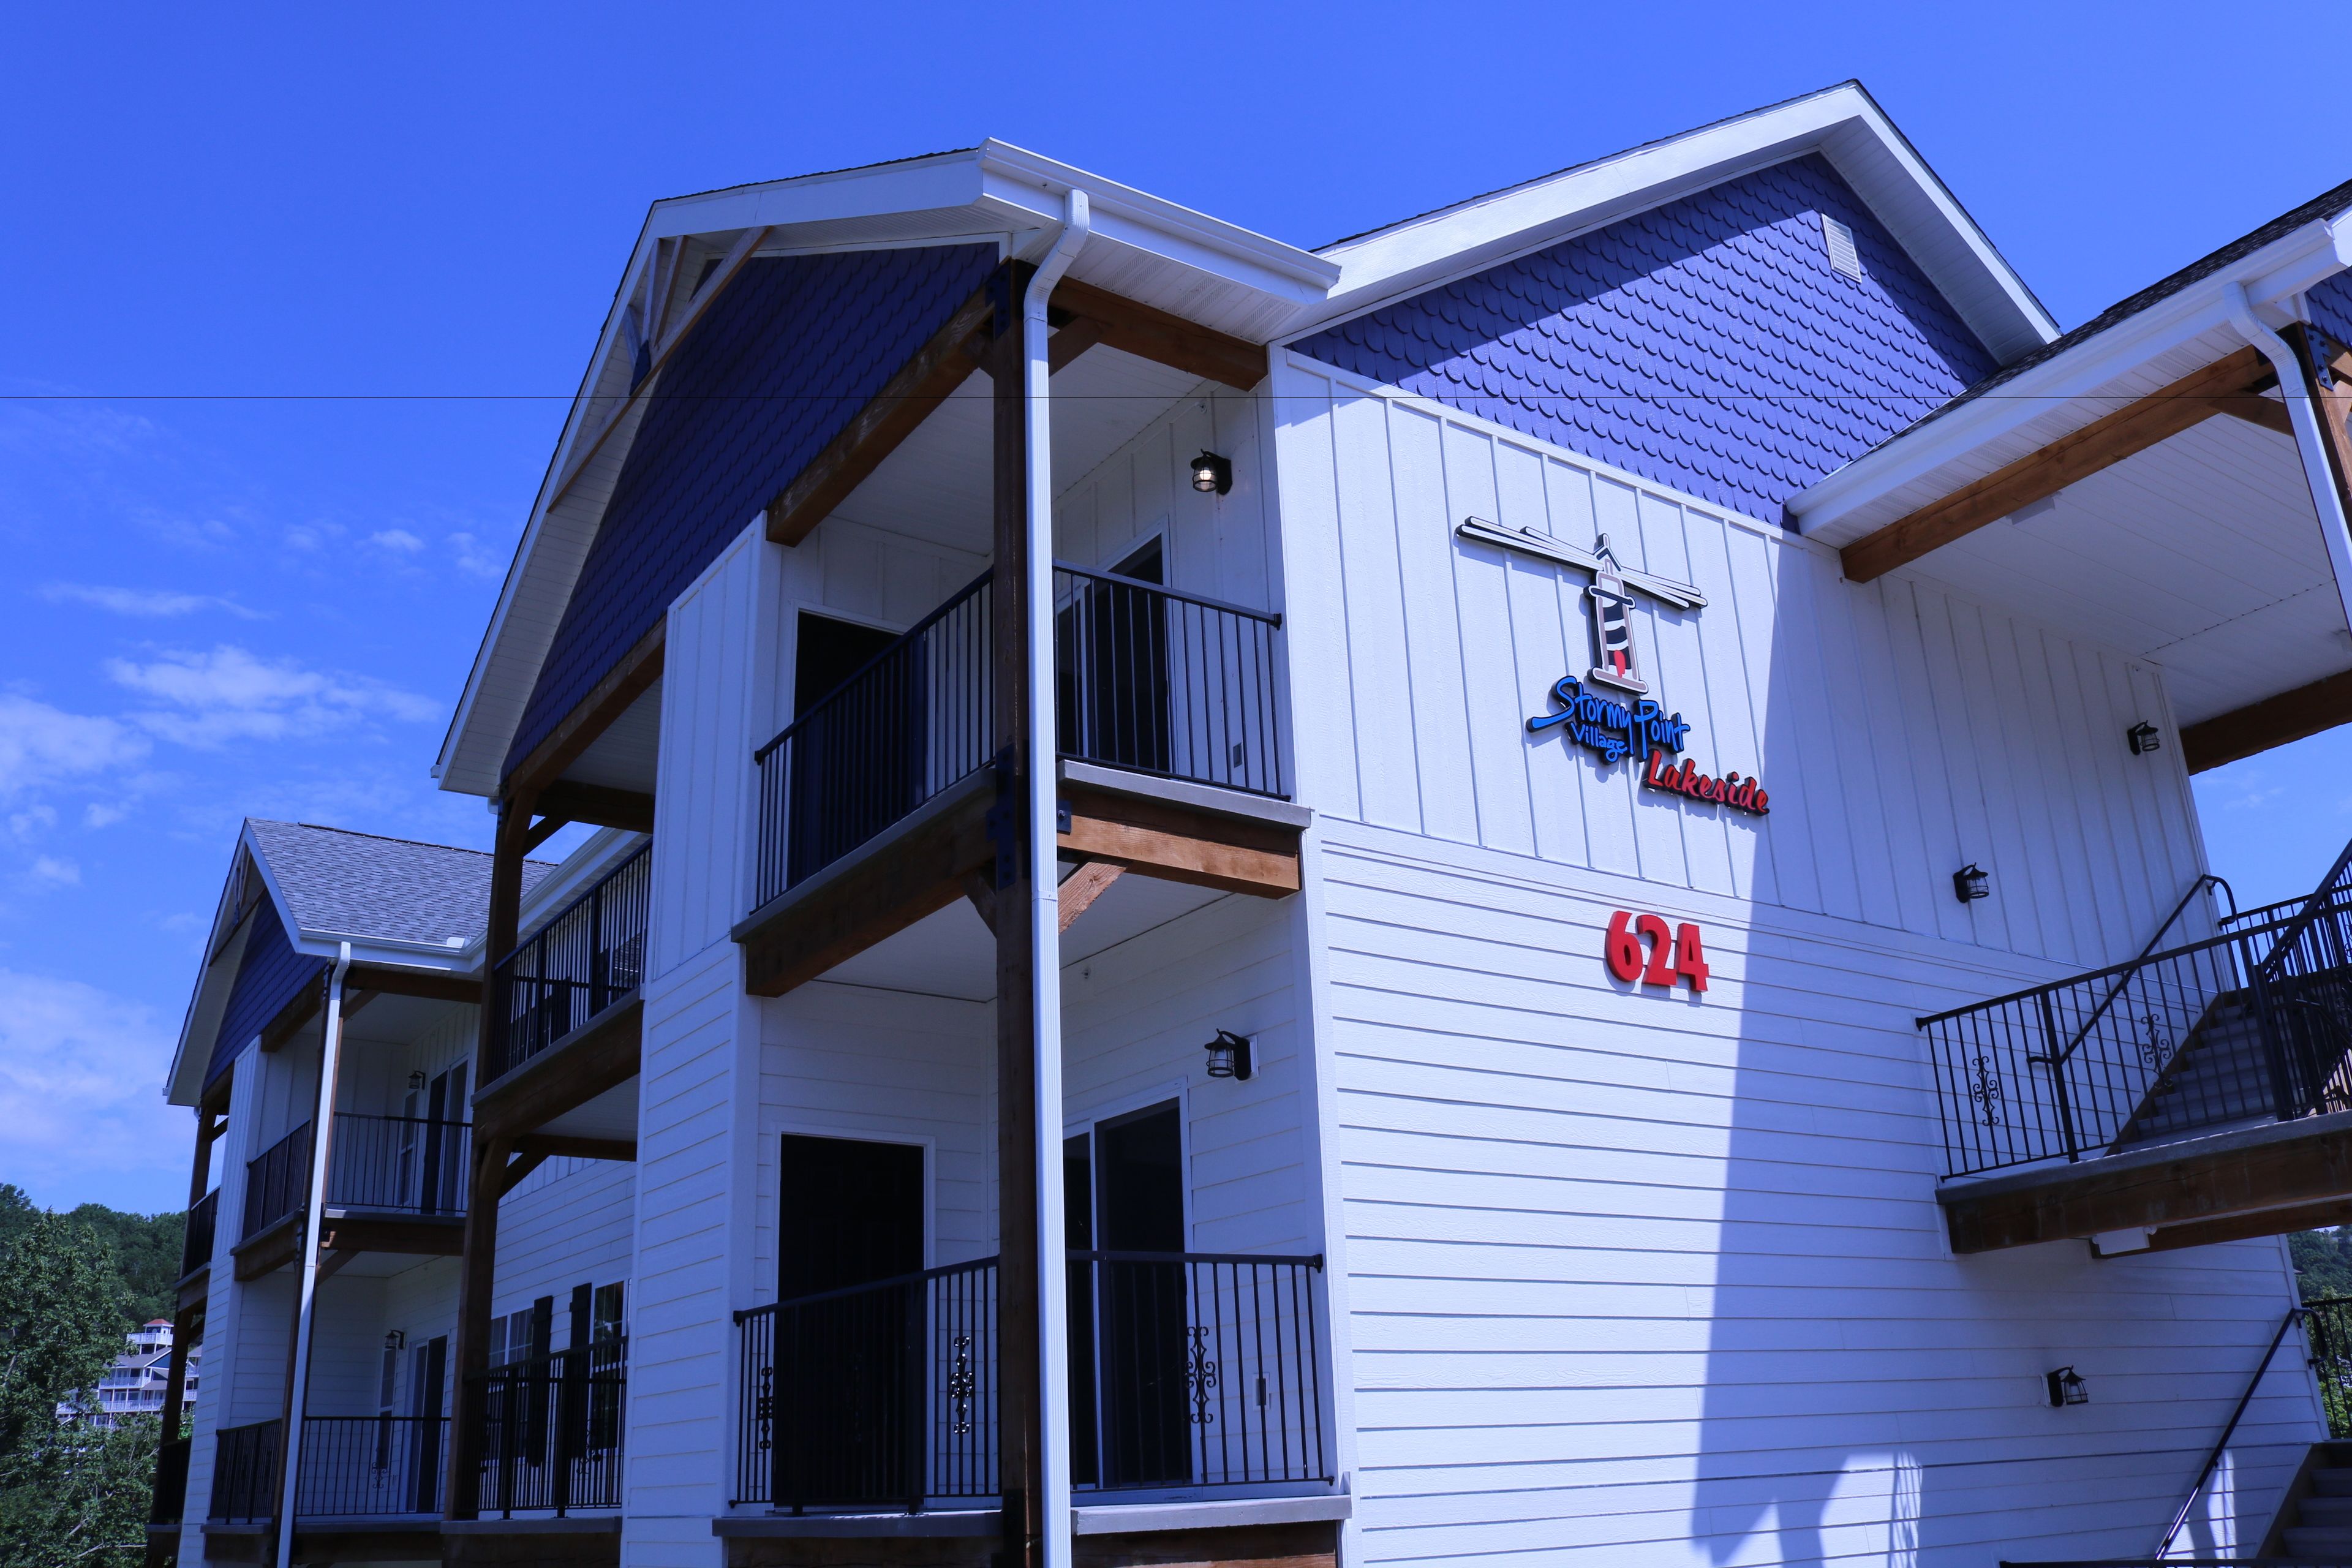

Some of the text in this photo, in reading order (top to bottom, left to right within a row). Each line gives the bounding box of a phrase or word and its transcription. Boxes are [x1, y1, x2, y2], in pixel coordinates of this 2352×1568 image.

[1528, 676, 1691, 761] Stormy Point
[1567, 721, 1628, 764] Village
[1644, 748, 1770, 816] Lakeside
[1605, 910, 1709, 993] 624
